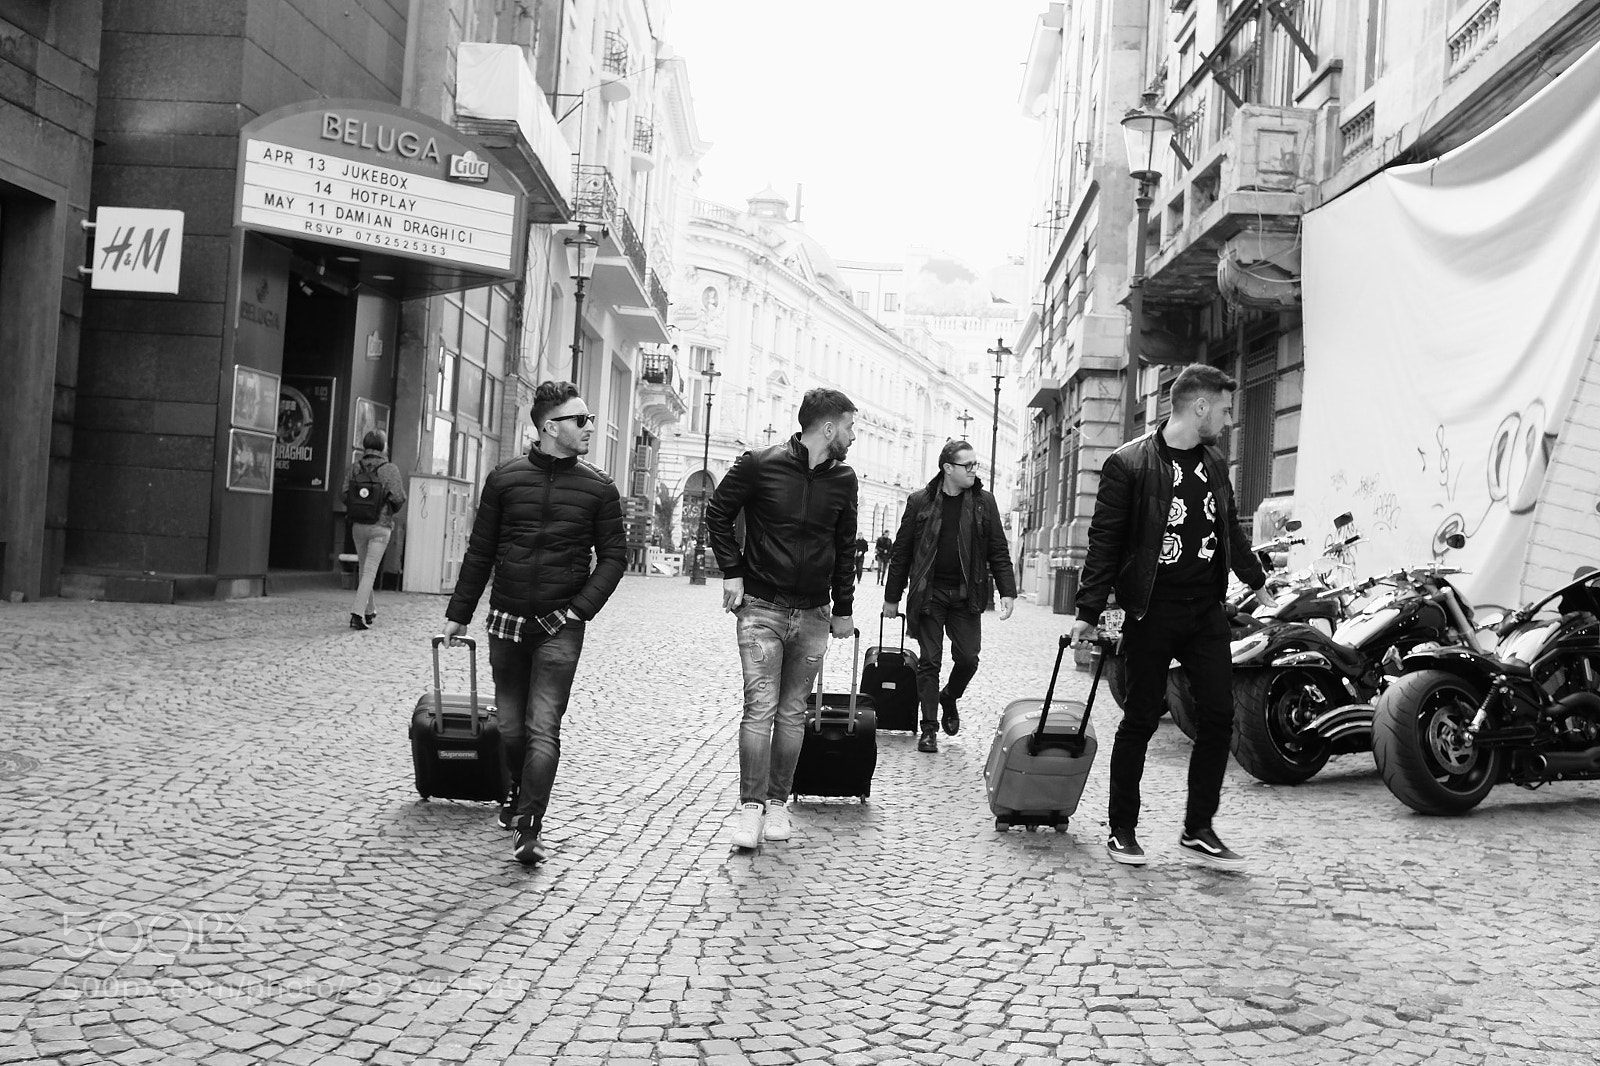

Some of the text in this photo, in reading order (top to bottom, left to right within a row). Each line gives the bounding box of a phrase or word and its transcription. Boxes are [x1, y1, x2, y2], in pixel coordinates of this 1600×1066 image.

[321, 111, 440, 163] BELUGA
[263, 147, 408, 190] APR 13 JUKEBOX
[264, 192, 472, 244] MAY 11 DAMIAN DRAGHICI
[315, 180, 416, 212] 14 HOTPLAY
[100, 226, 171, 275] H&M
[304, 221, 446, 256] RSVP 0752525353
